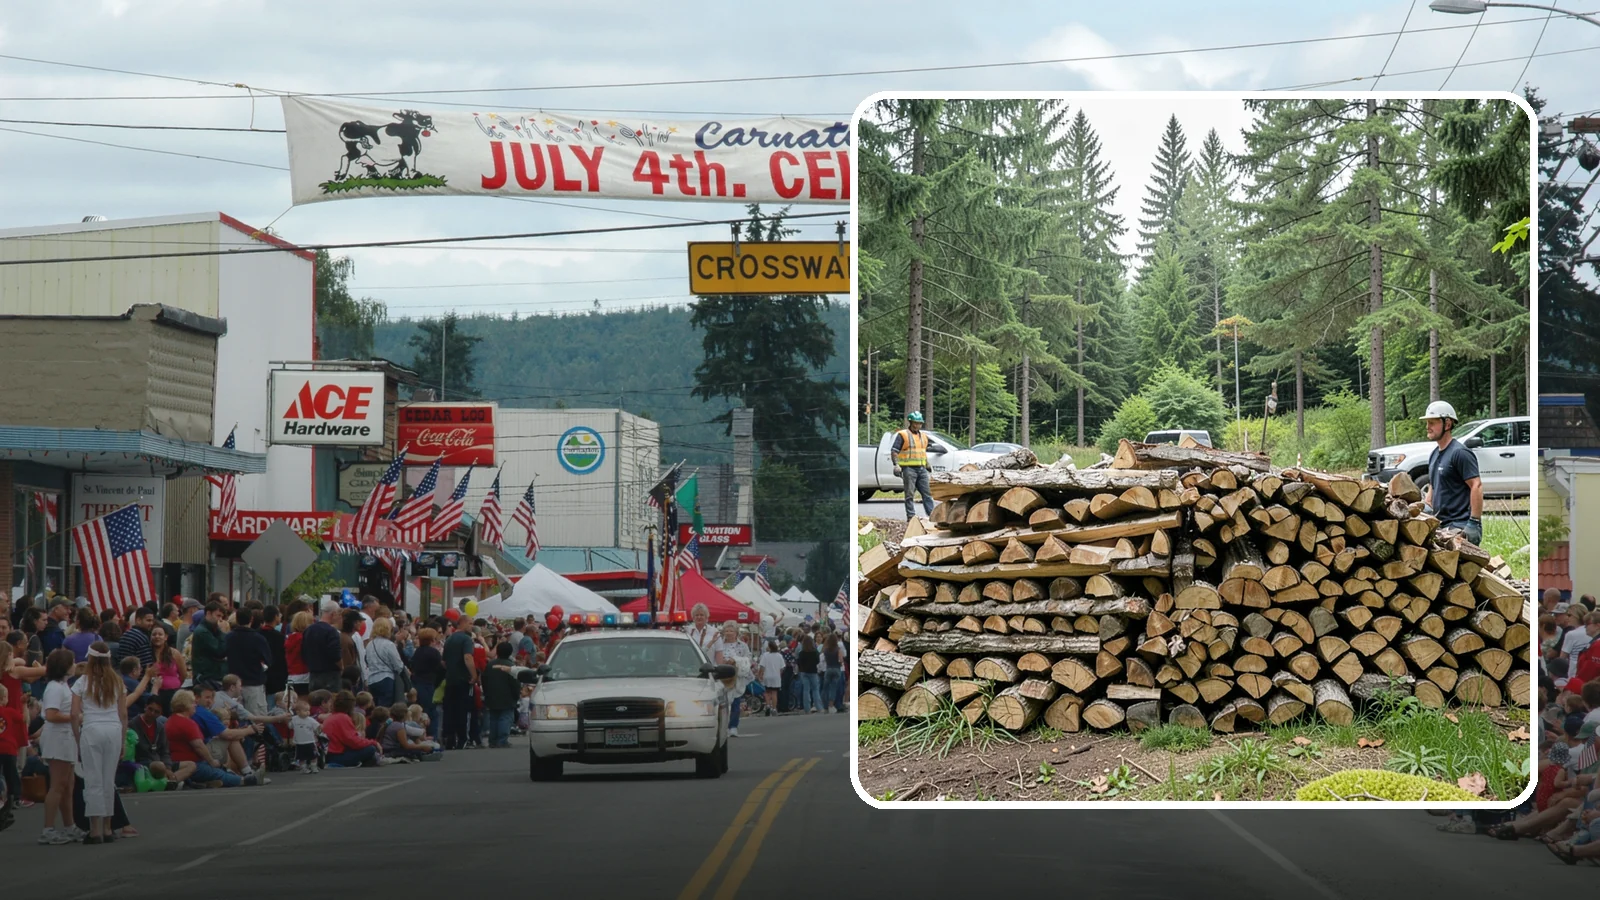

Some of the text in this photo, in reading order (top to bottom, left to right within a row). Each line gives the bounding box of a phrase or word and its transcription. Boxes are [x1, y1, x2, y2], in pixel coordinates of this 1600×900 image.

[481, 141, 605, 192] JULY
[632, 150, 746, 198] 4th.
[282, 380, 373, 420] ACE
[405, 409, 455, 423] CEDAR
[283, 420, 371, 437] Hardware
[416, 428, 477, 447] Coca-Cola
[353, 467, 386, 480] Simpl
[95, 484, 125, 495] Vincent
[126, 485, 136, 495] de
[137, 485, 155, 496] Paul
[688, 526, 741, 536] CRNATION
[699, 535, 730, 543] GLASS
